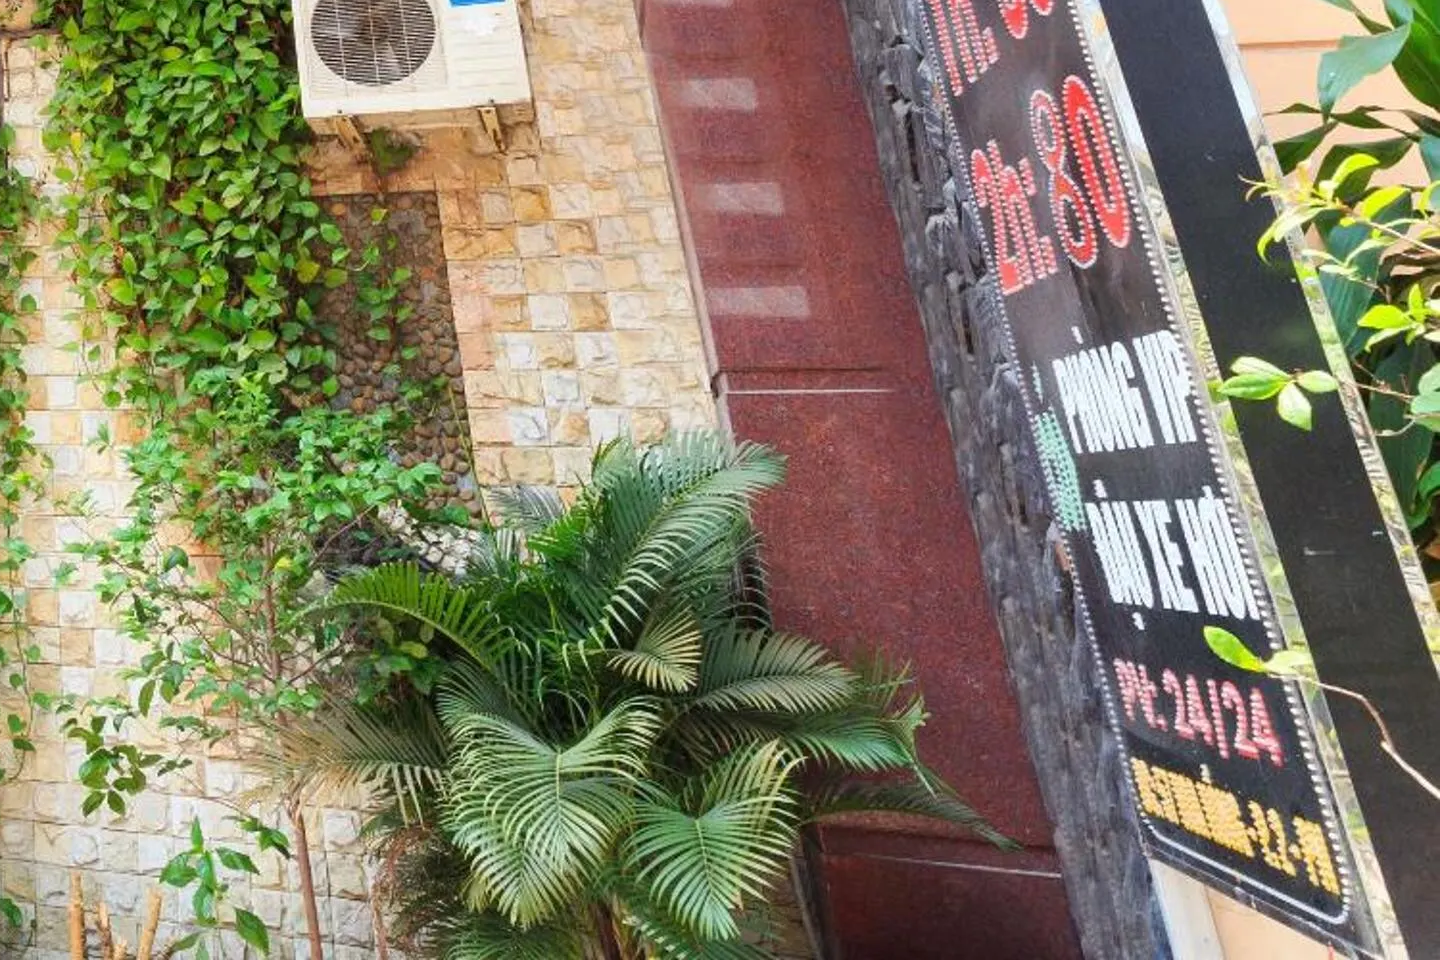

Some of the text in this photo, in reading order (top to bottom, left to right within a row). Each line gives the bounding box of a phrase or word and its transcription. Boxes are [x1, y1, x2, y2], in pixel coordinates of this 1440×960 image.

[1028, 74, 1130, 269] 80
[1051, 326, 1156, 455] PHÒNG
[1131, 328, 1198, 445] VIP
[1131, 499, 1200, 614] XE
